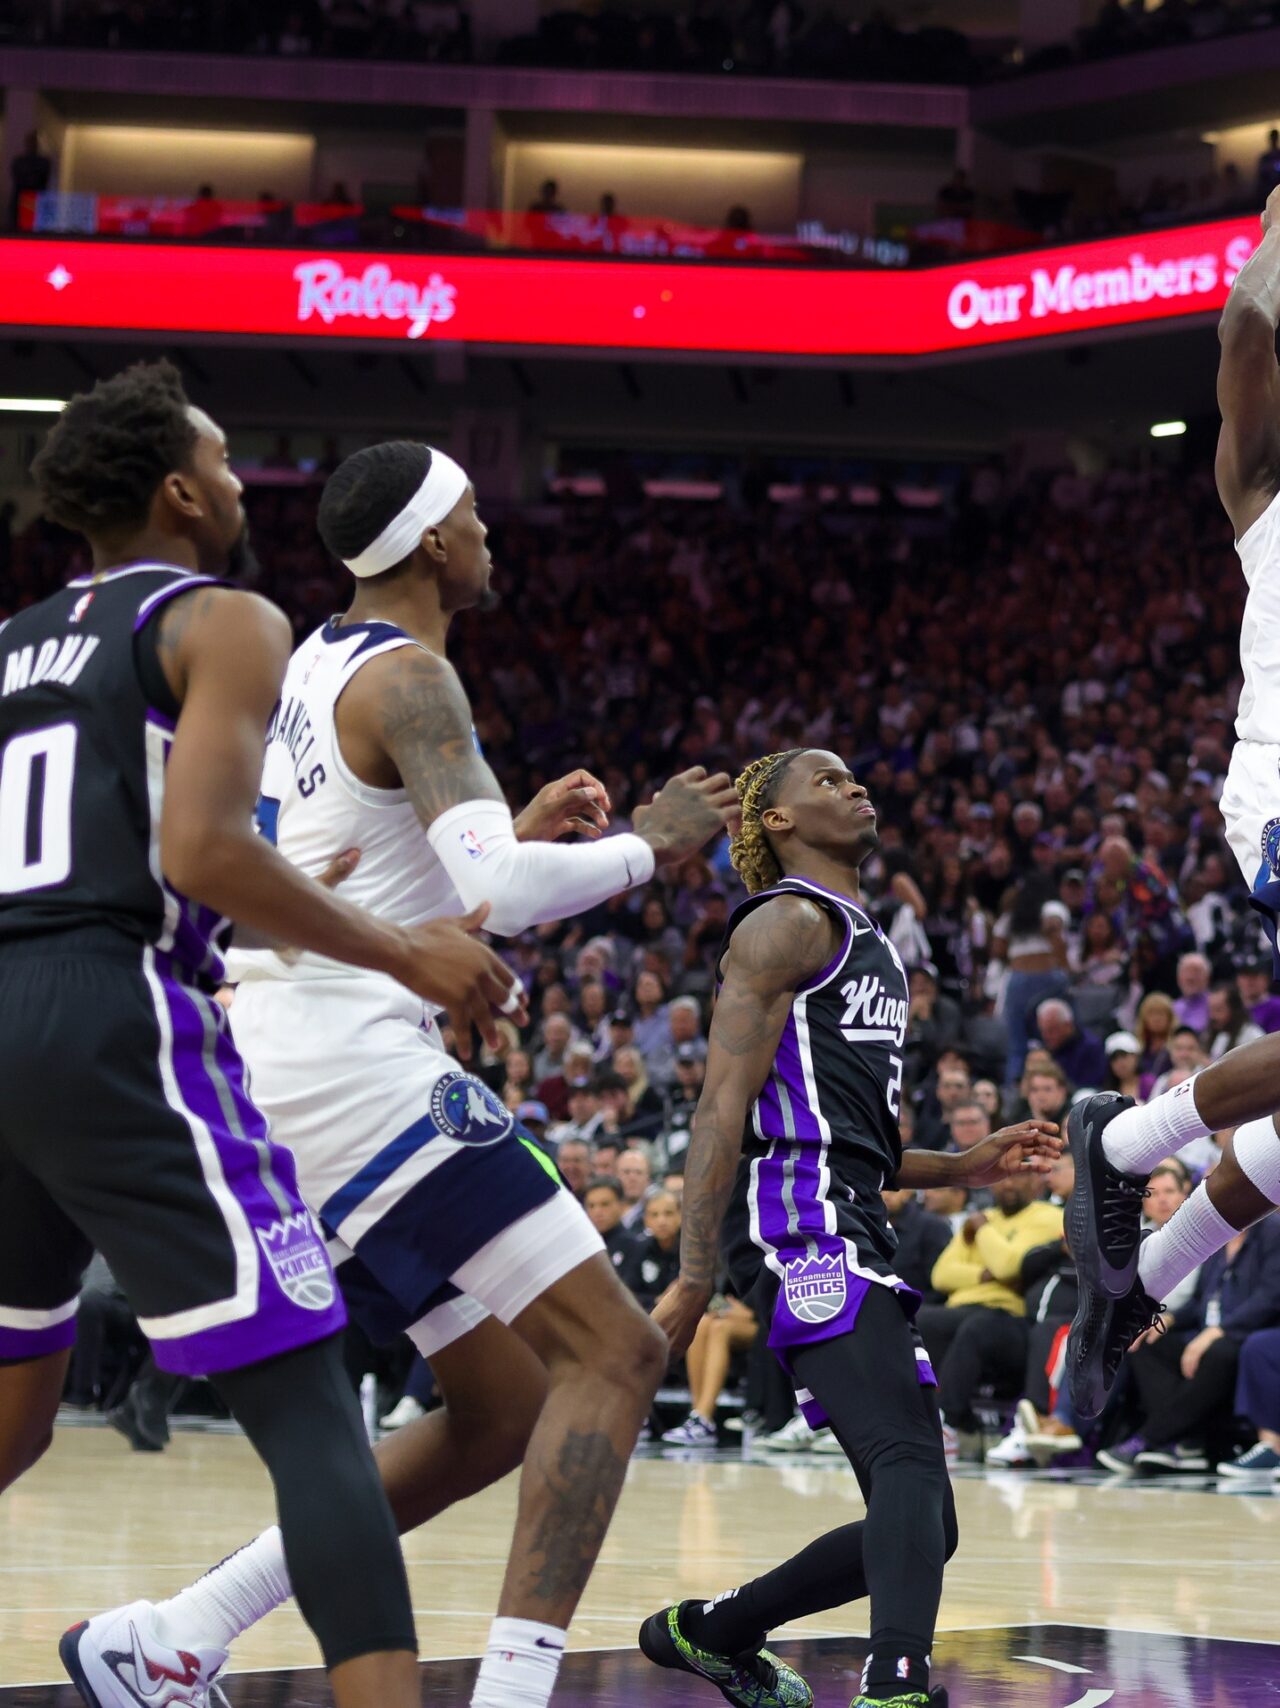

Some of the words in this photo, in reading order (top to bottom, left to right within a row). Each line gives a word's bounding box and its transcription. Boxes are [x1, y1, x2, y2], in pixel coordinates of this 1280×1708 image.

[293, 259, 458, 339] Raley's
[947, 279, 1026, 330] Our
[1030, 253, 1219, 318] Members
[0, 721, 78, 894] 0
[839, 975, 909, 1048] King
[787, 1280, 845, 1301] KINGS
[788, 1271, 842, 1285] SACRAMENTO
